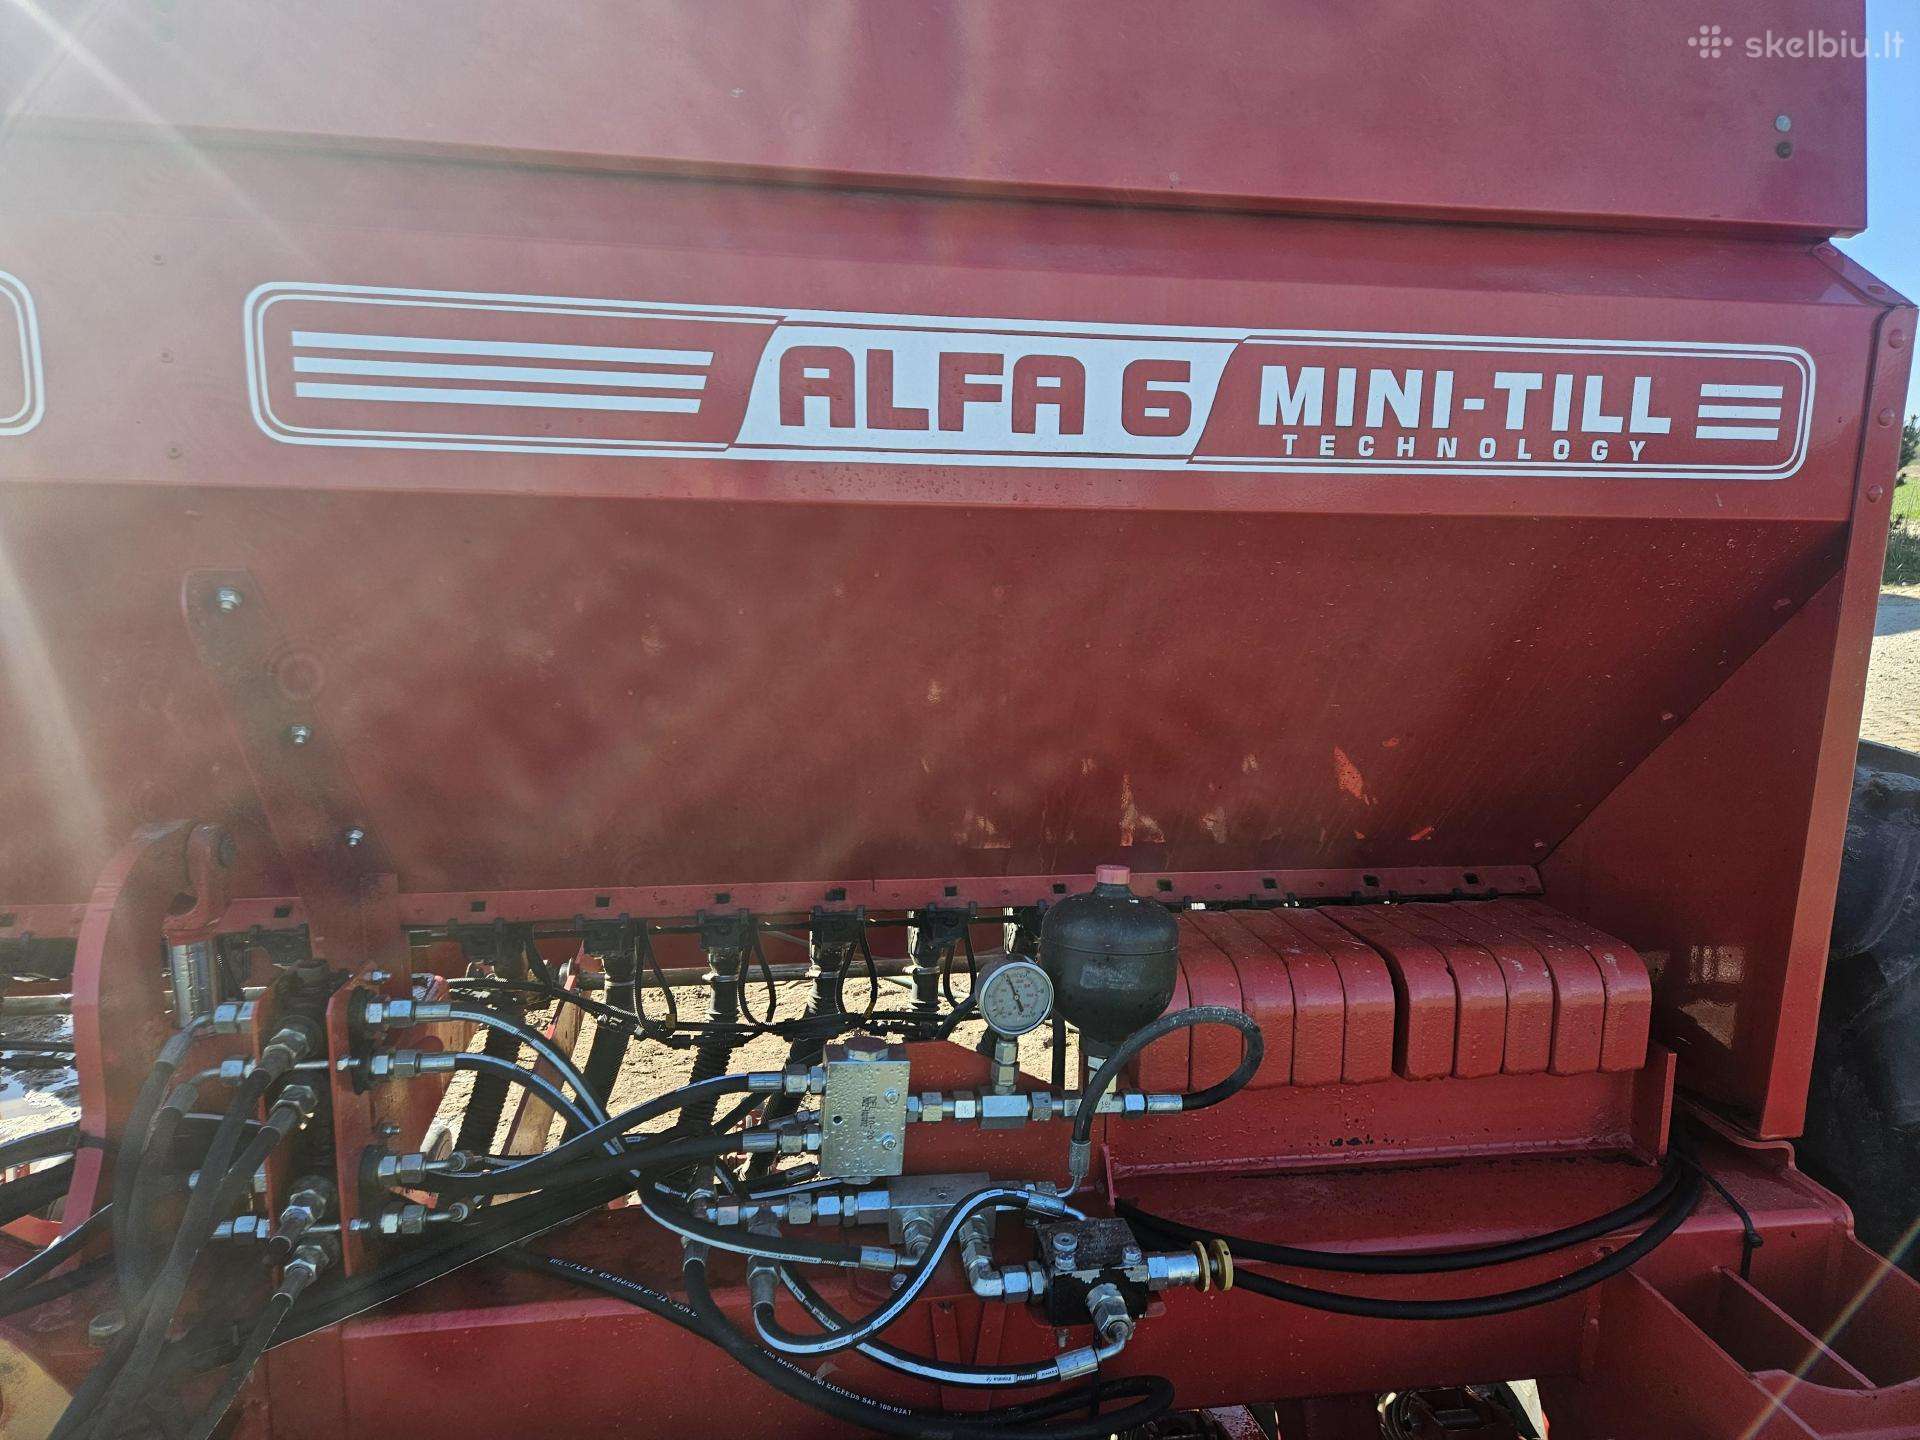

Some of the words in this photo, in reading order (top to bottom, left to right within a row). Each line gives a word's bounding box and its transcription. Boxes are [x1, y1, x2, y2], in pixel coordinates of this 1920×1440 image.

[779, 345, 1086, 435] ALFA
[1121, 358, 1192, 437] 6
[1258, 365, 1672, 434] MINI-TILL
[1282, 434, 1646, 461] TECHNOLOGY
[826, 1381, 860, 1401] EXCEEDS
